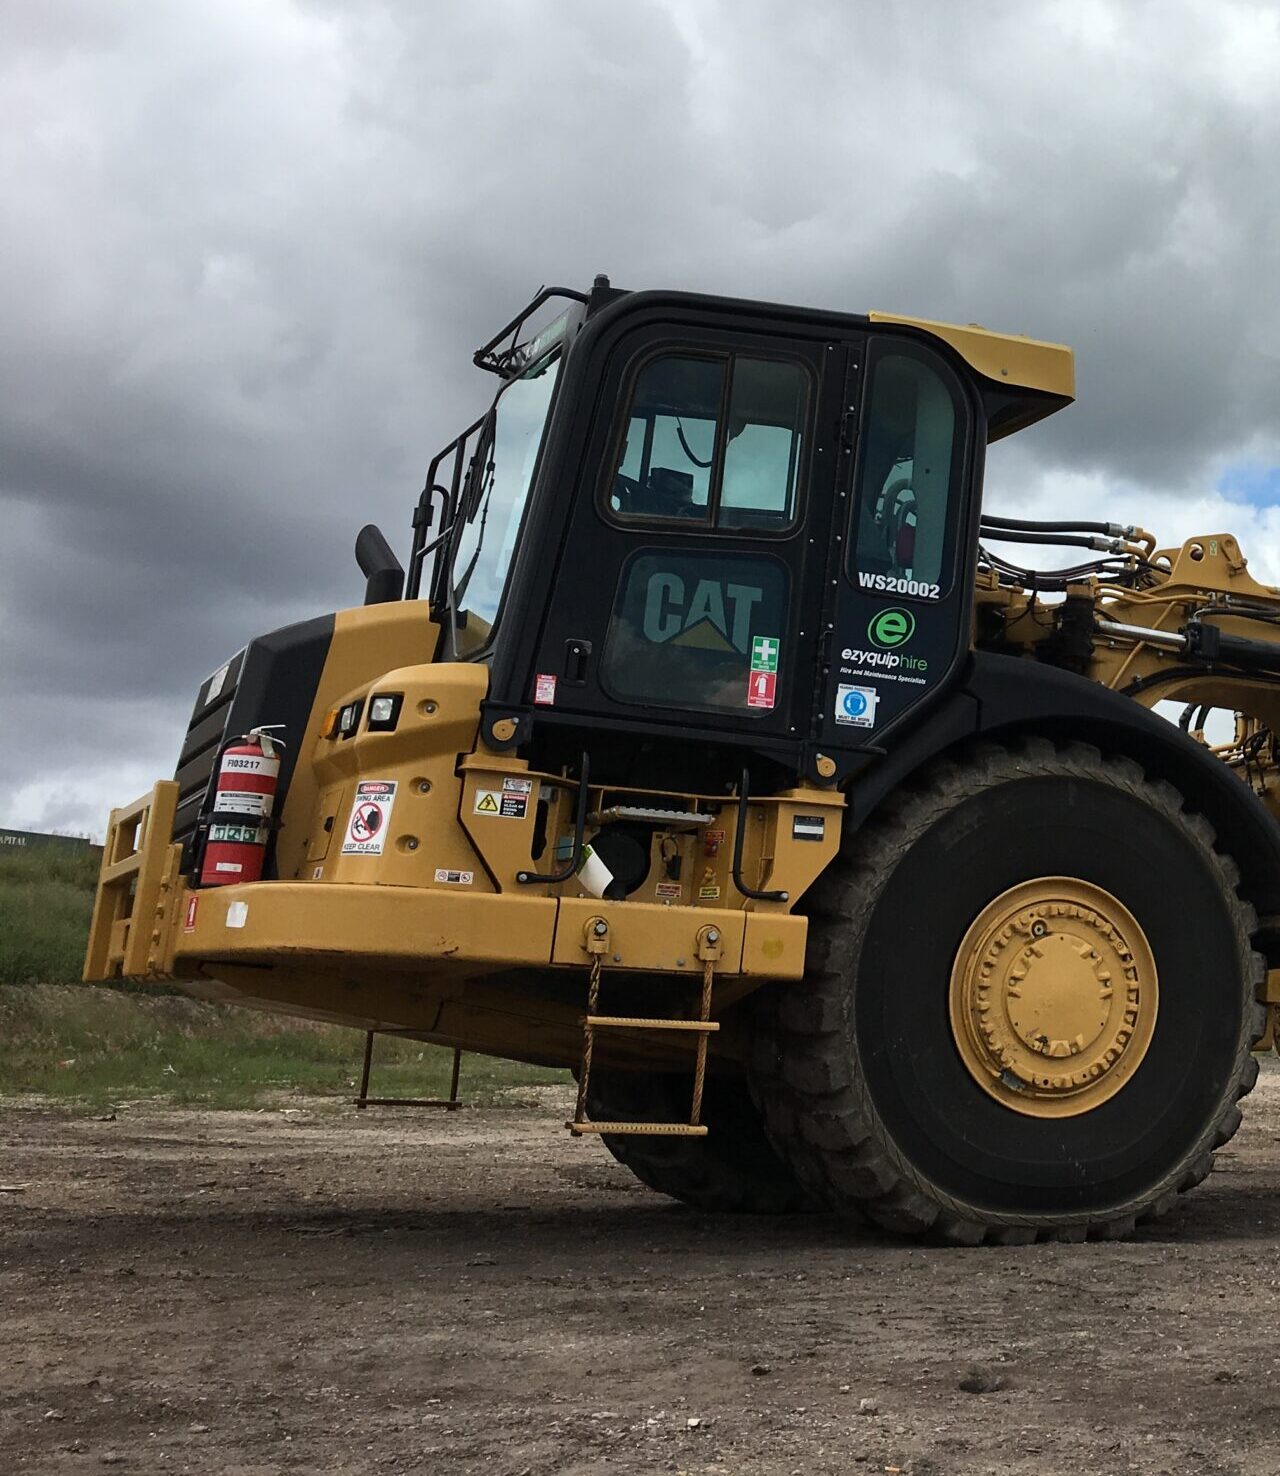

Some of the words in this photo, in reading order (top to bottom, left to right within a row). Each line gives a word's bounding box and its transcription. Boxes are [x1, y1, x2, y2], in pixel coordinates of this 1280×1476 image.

[858, 571, 940, 599] WS20002
[643, 572, 763, 655] CAT
[841, 648, 928, 671] ezyquiphire
[840, 666, 852, 674] Hire
[852, 668, 863, 676] and
[863, 670, 897, 681] Maintenance
[897, 675, 927, 685] Specialists
